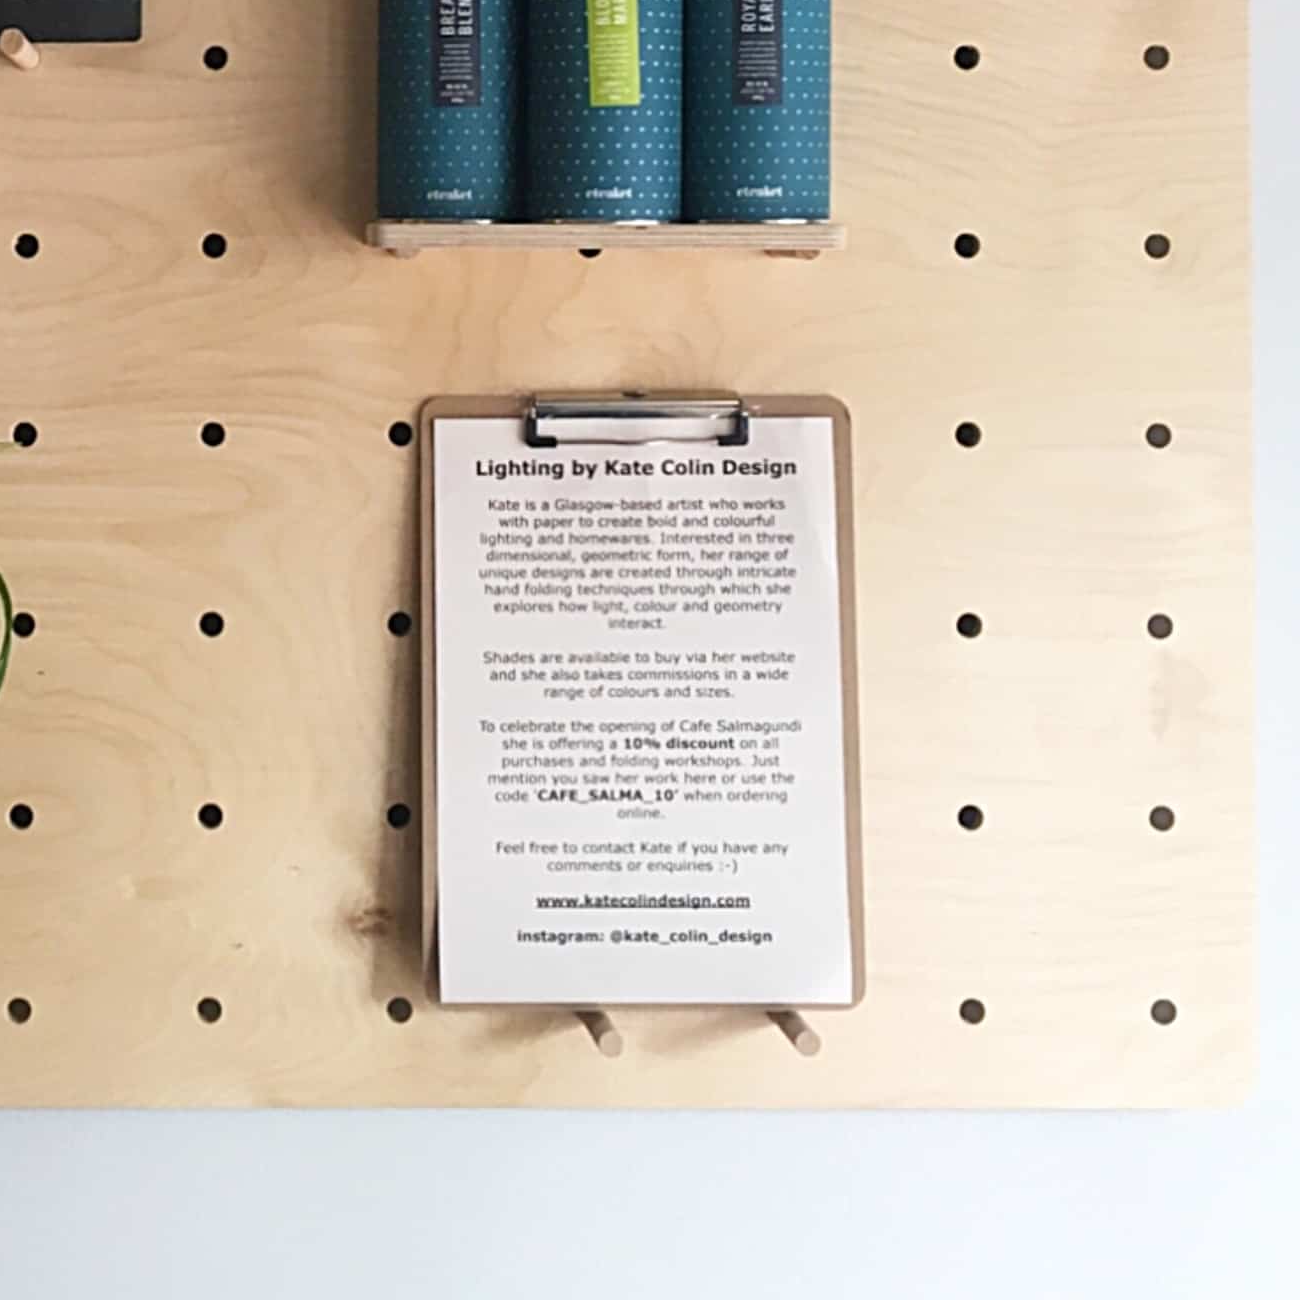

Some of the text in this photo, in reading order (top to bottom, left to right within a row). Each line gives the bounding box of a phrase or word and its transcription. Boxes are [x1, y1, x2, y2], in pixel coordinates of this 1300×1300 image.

[476, 459, 796, 480] Lighting by Kate Colin Design
[488, 500, 520, 512] Kate
[524, 500, 537, 512] is
[540, 500, 550, 512] a
[666, 499, 704, 511] artist
[708, 498, 738, 511] who
[742, 498, 786, 510] works
[498, 514, 776, 530] with paper to create bold and colourful
[479, 532, 533, 547] lighting
[537, 532, 564, 546] and
[660, 532, 734, 545] Interested
[738, 532, 752, 544] in
[756, 531, 795, 544] three
[580, 549, 652, 564] geometric
[700, 548, 725, 562] her
[728, 550, 770, 564] range
[774, 548, 789, 562] of
[482, 650, 796, 666] Shades are available to buy via her website
[489, 668, 790, 682] and she also takes commissions in a wide
[543, 687, 585, 701] range
[588, 685, 604, 699] of
[607, 686, 660, 698] colours
[663, 685, 691, 698] and
[478, 719, 802, 735] To celebrate the opening of Cafe Salmagundi
[502, 737, 779, 752] she is offering a 10% discount on all
[501, 754, 575, 770] purchases
[578, 754, 606, 768] and
[610, 754, 660, 770] folding
[751, 754, 780, 767] Just
[495, 790, 528, 802] code
[684, 789, 722, 801] when
[727, 790, 788, 804] ordering
[496, 840, 788, 857] Feel free to contact Kate if you have any
[546, 860, 714, 874] comments or enquiries
[536, 894, 751, 910] www.katecolindesign.com
[516, 929, 773, 946] instagram: @kate_colin_design
